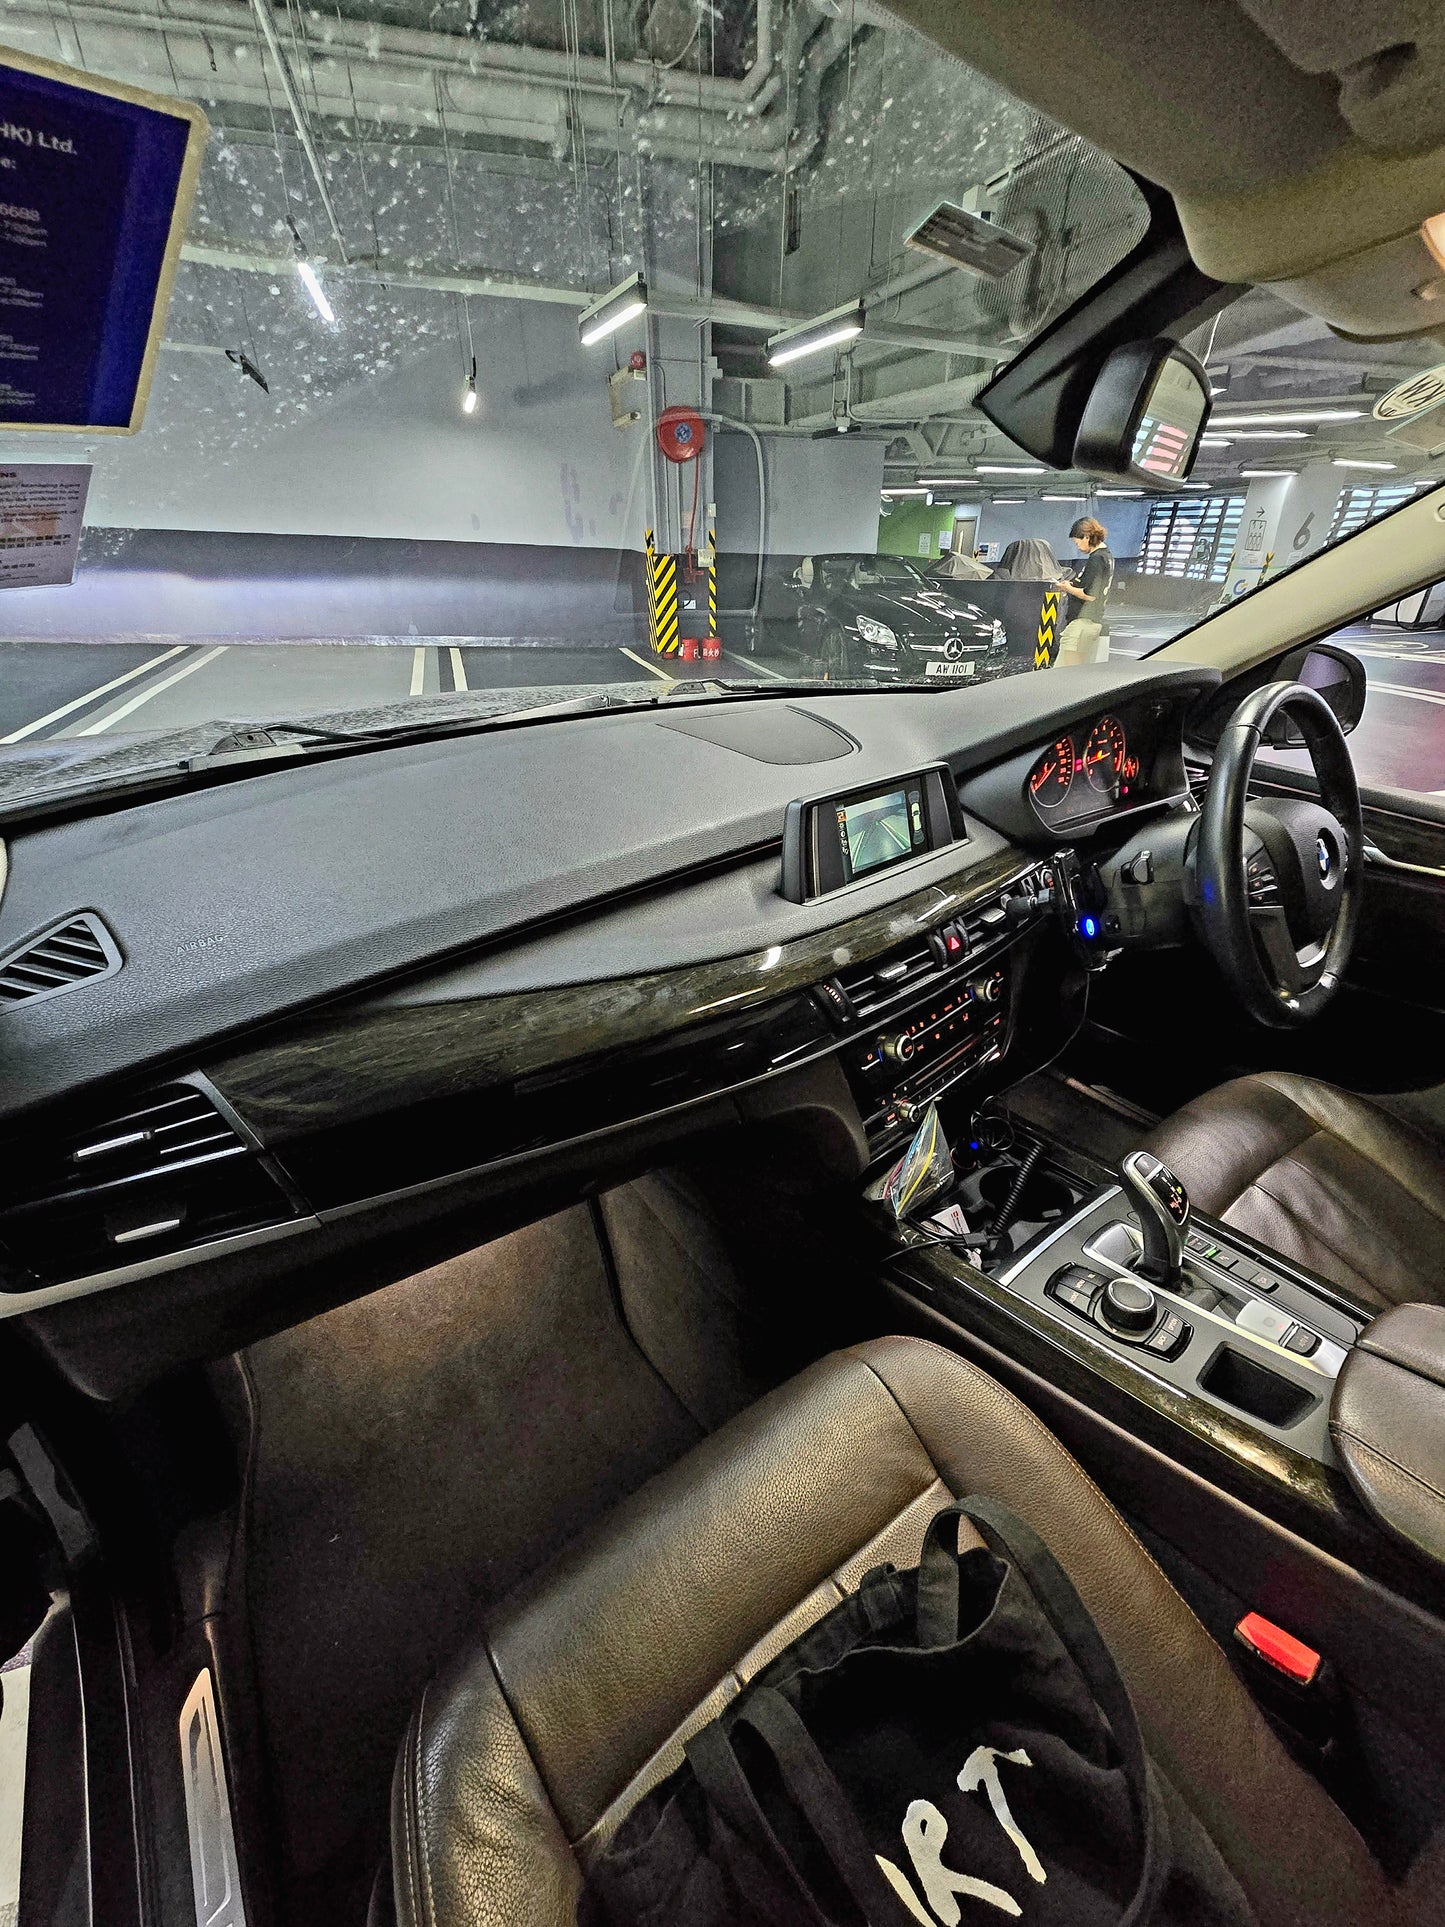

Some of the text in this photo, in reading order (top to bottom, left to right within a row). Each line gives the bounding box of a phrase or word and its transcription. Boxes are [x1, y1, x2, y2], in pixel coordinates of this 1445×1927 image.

[38, 131, 78, 155] Ltd.
[1293, 511, 1315, 550] 6
[176, 934, 224, 955] AIRBAG
